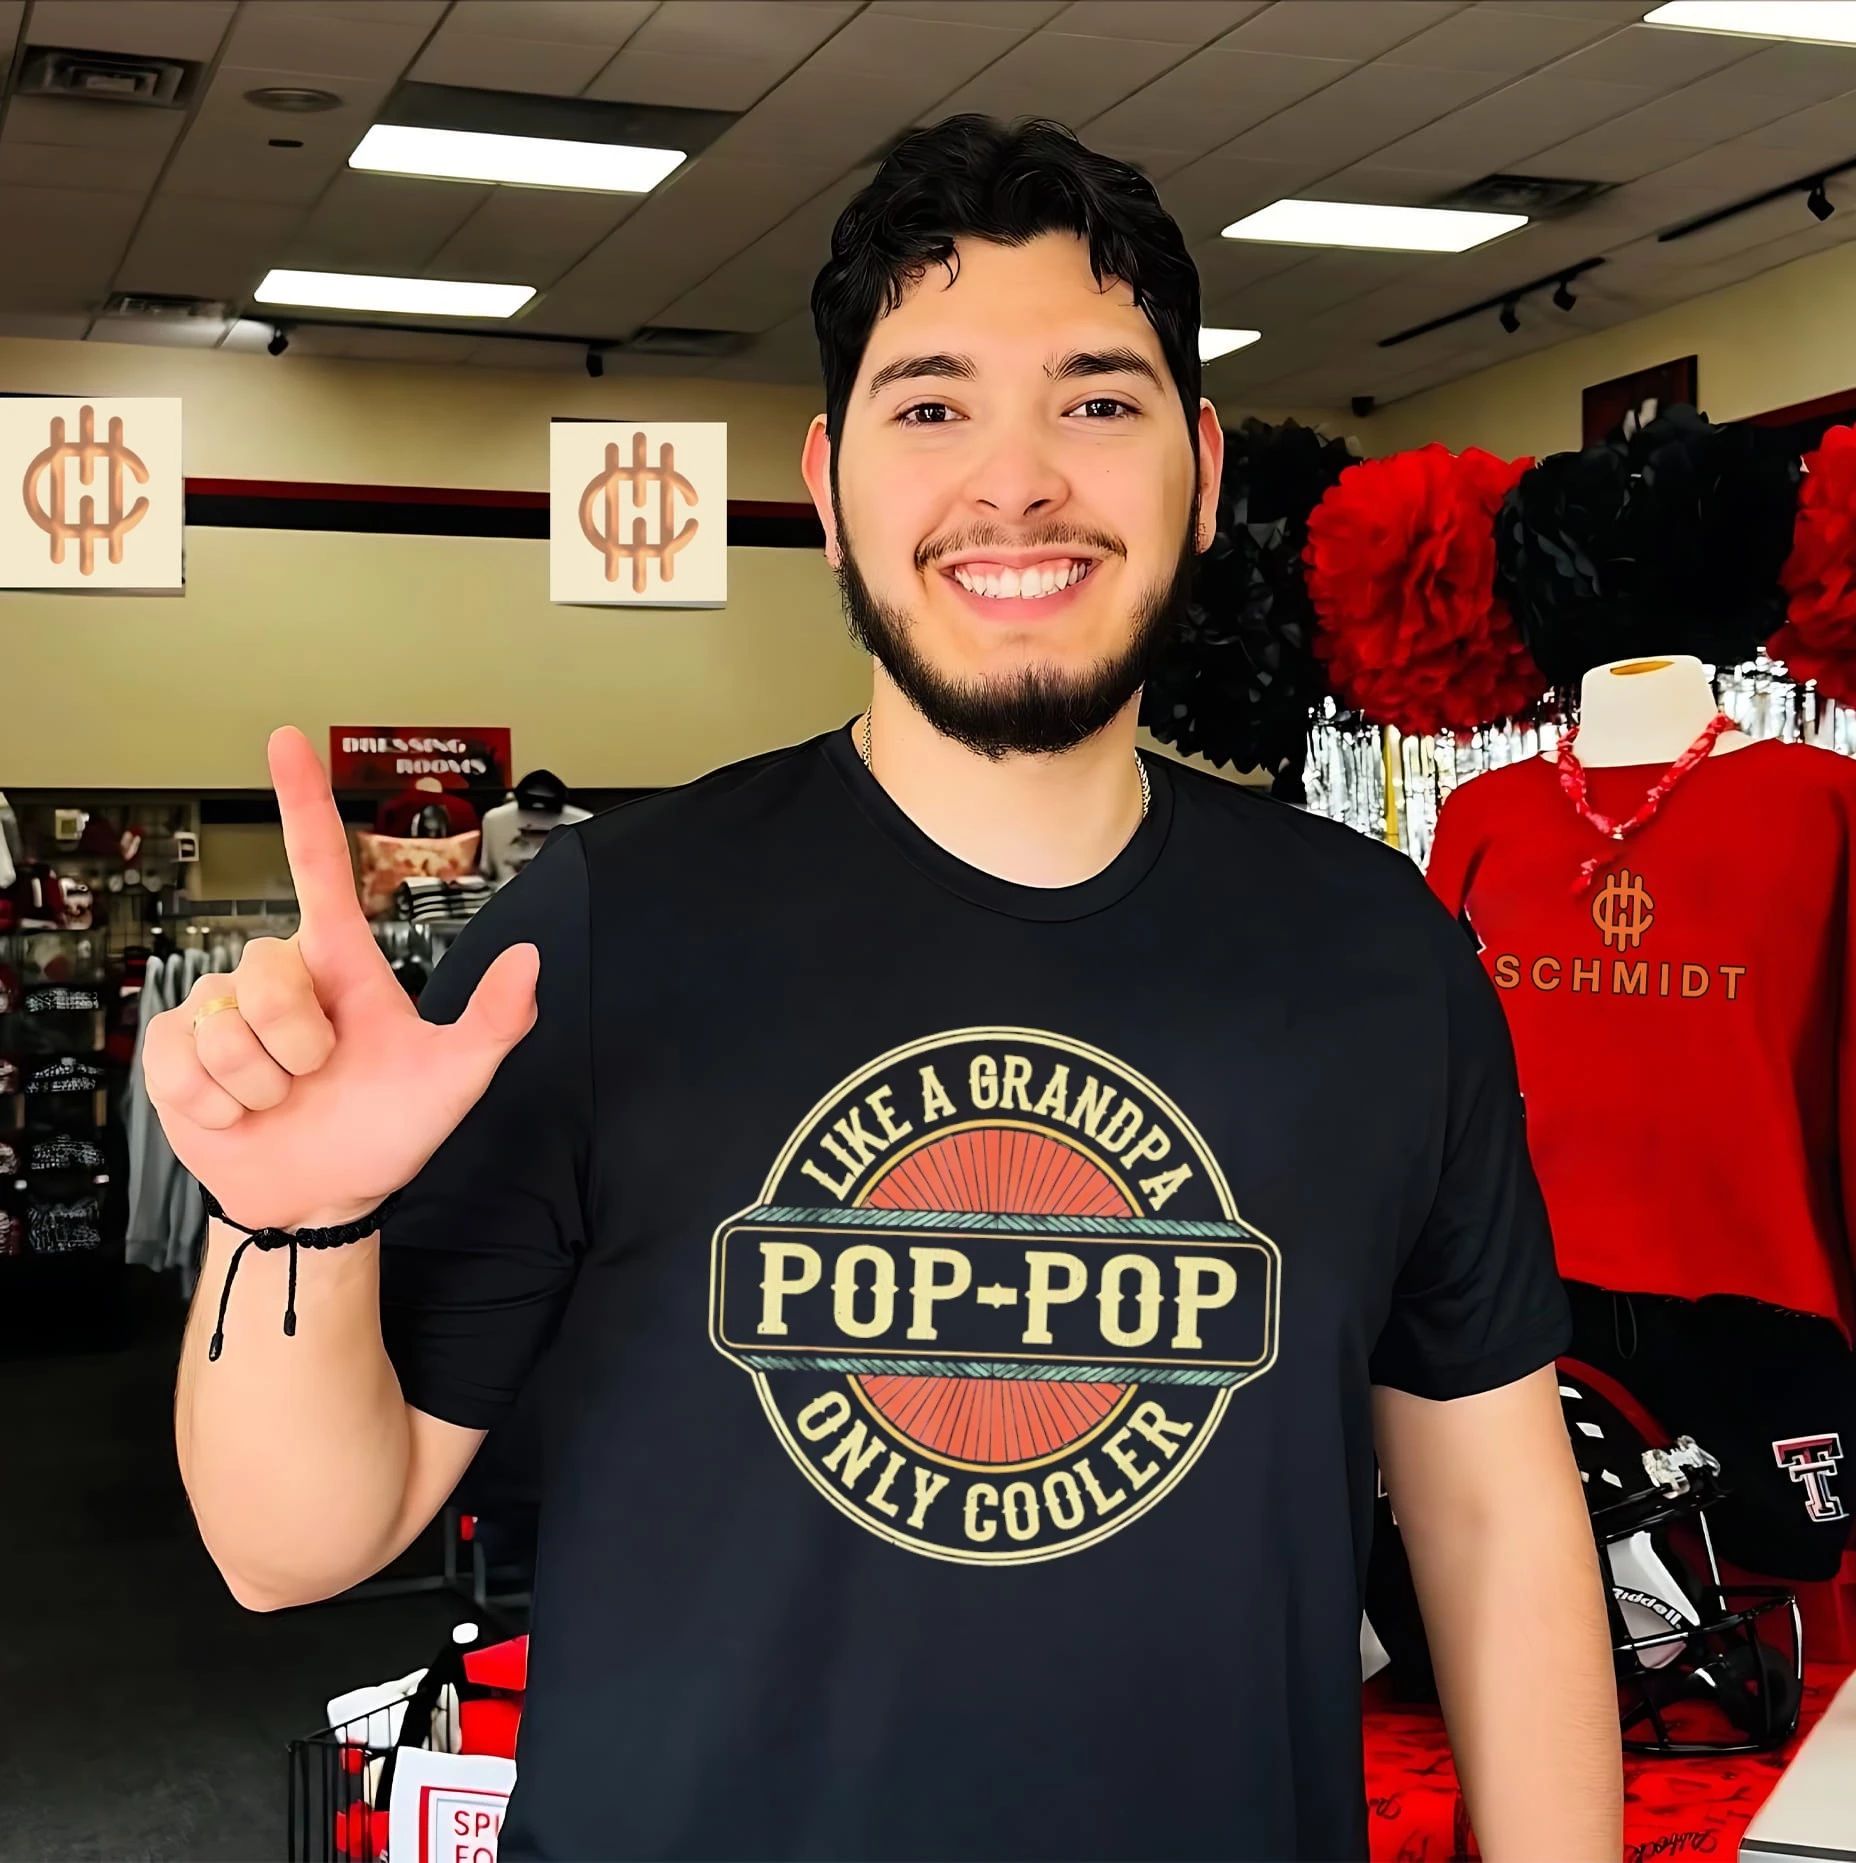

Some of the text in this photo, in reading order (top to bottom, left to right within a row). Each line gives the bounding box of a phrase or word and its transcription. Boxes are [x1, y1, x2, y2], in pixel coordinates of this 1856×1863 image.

[342, 737, 466, 754] DRESSING
[396, 758, 487, 775] ROOMS
[1494, 954, 1747, 1000] SCHMIDT
[801, 1054, 1194, 1212] LIKE A GRANDPA
[757, 1242, 1238, 1349] POP-POP
[797, 1391, 1194, 1542] ONLY COOLER
